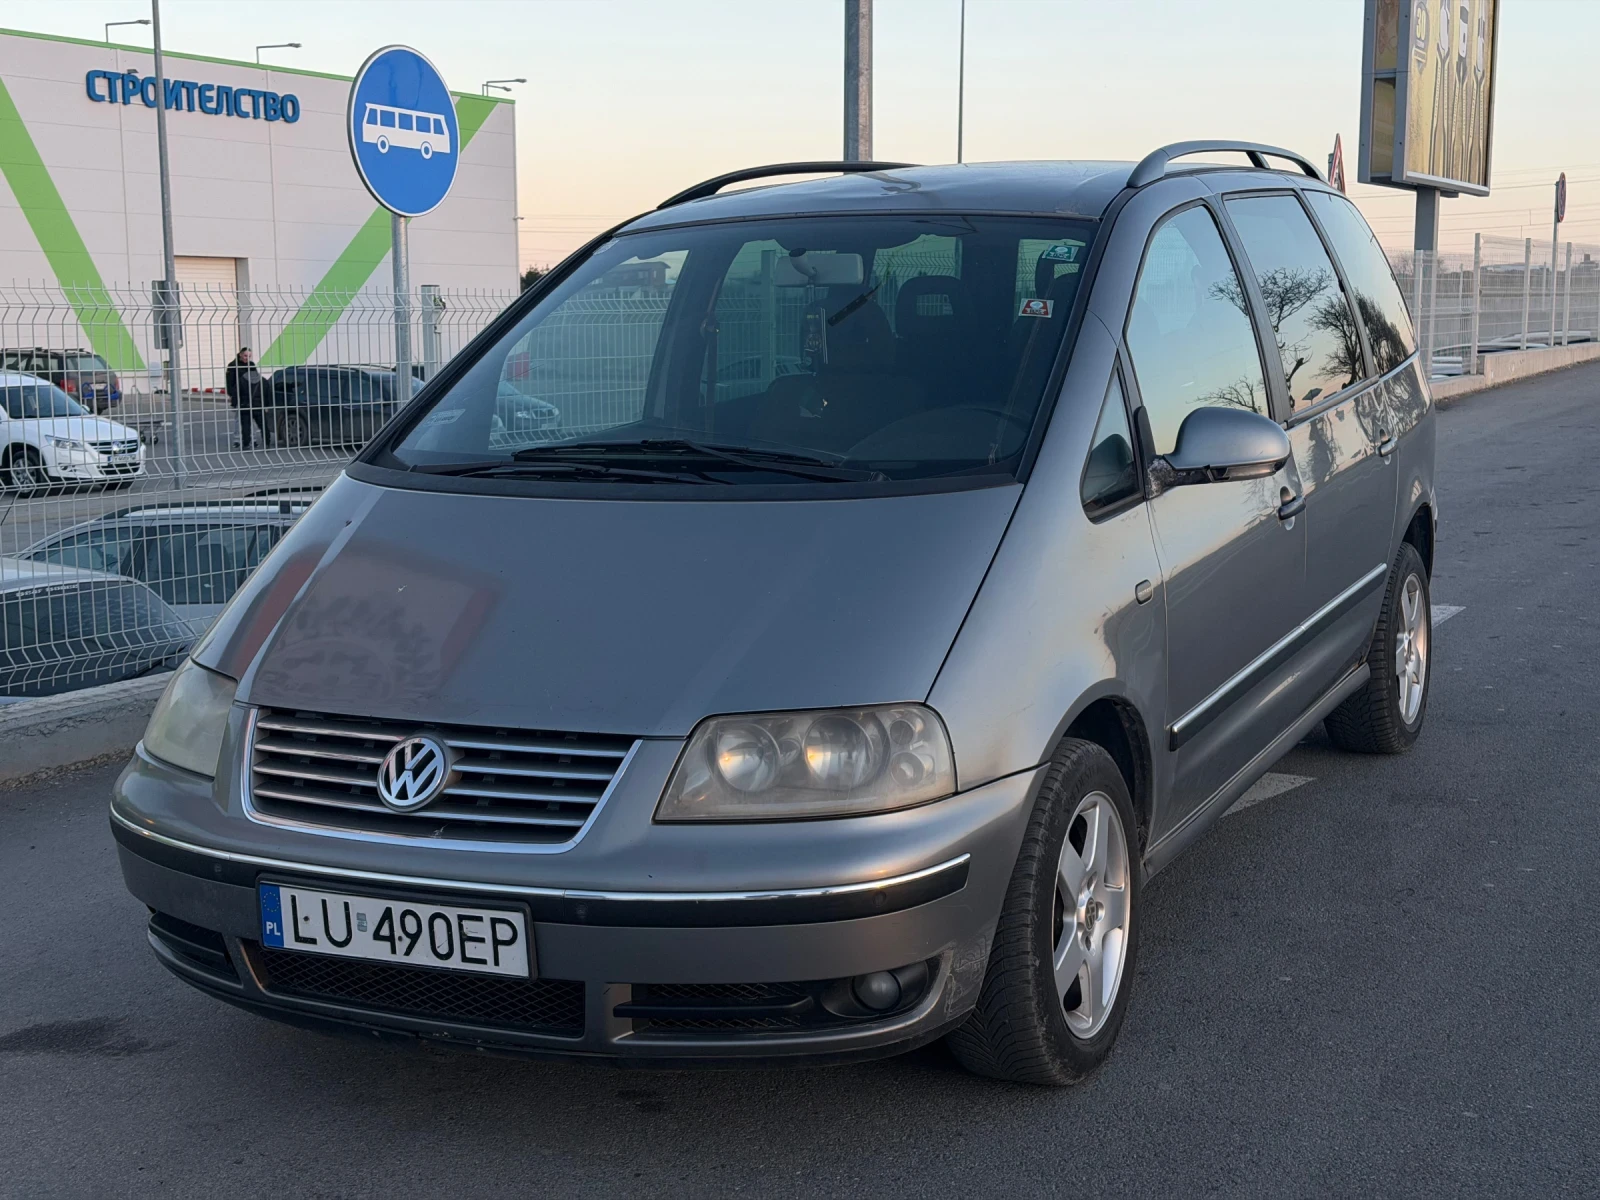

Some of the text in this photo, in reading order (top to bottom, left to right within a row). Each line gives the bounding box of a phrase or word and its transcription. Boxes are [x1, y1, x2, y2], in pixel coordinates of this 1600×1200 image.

[86, 69, 300, 124] СТРОИТЕЛСТВО
[266, 921, 281, 936] PL
[290, 894, 518, 967] LU 490EP
